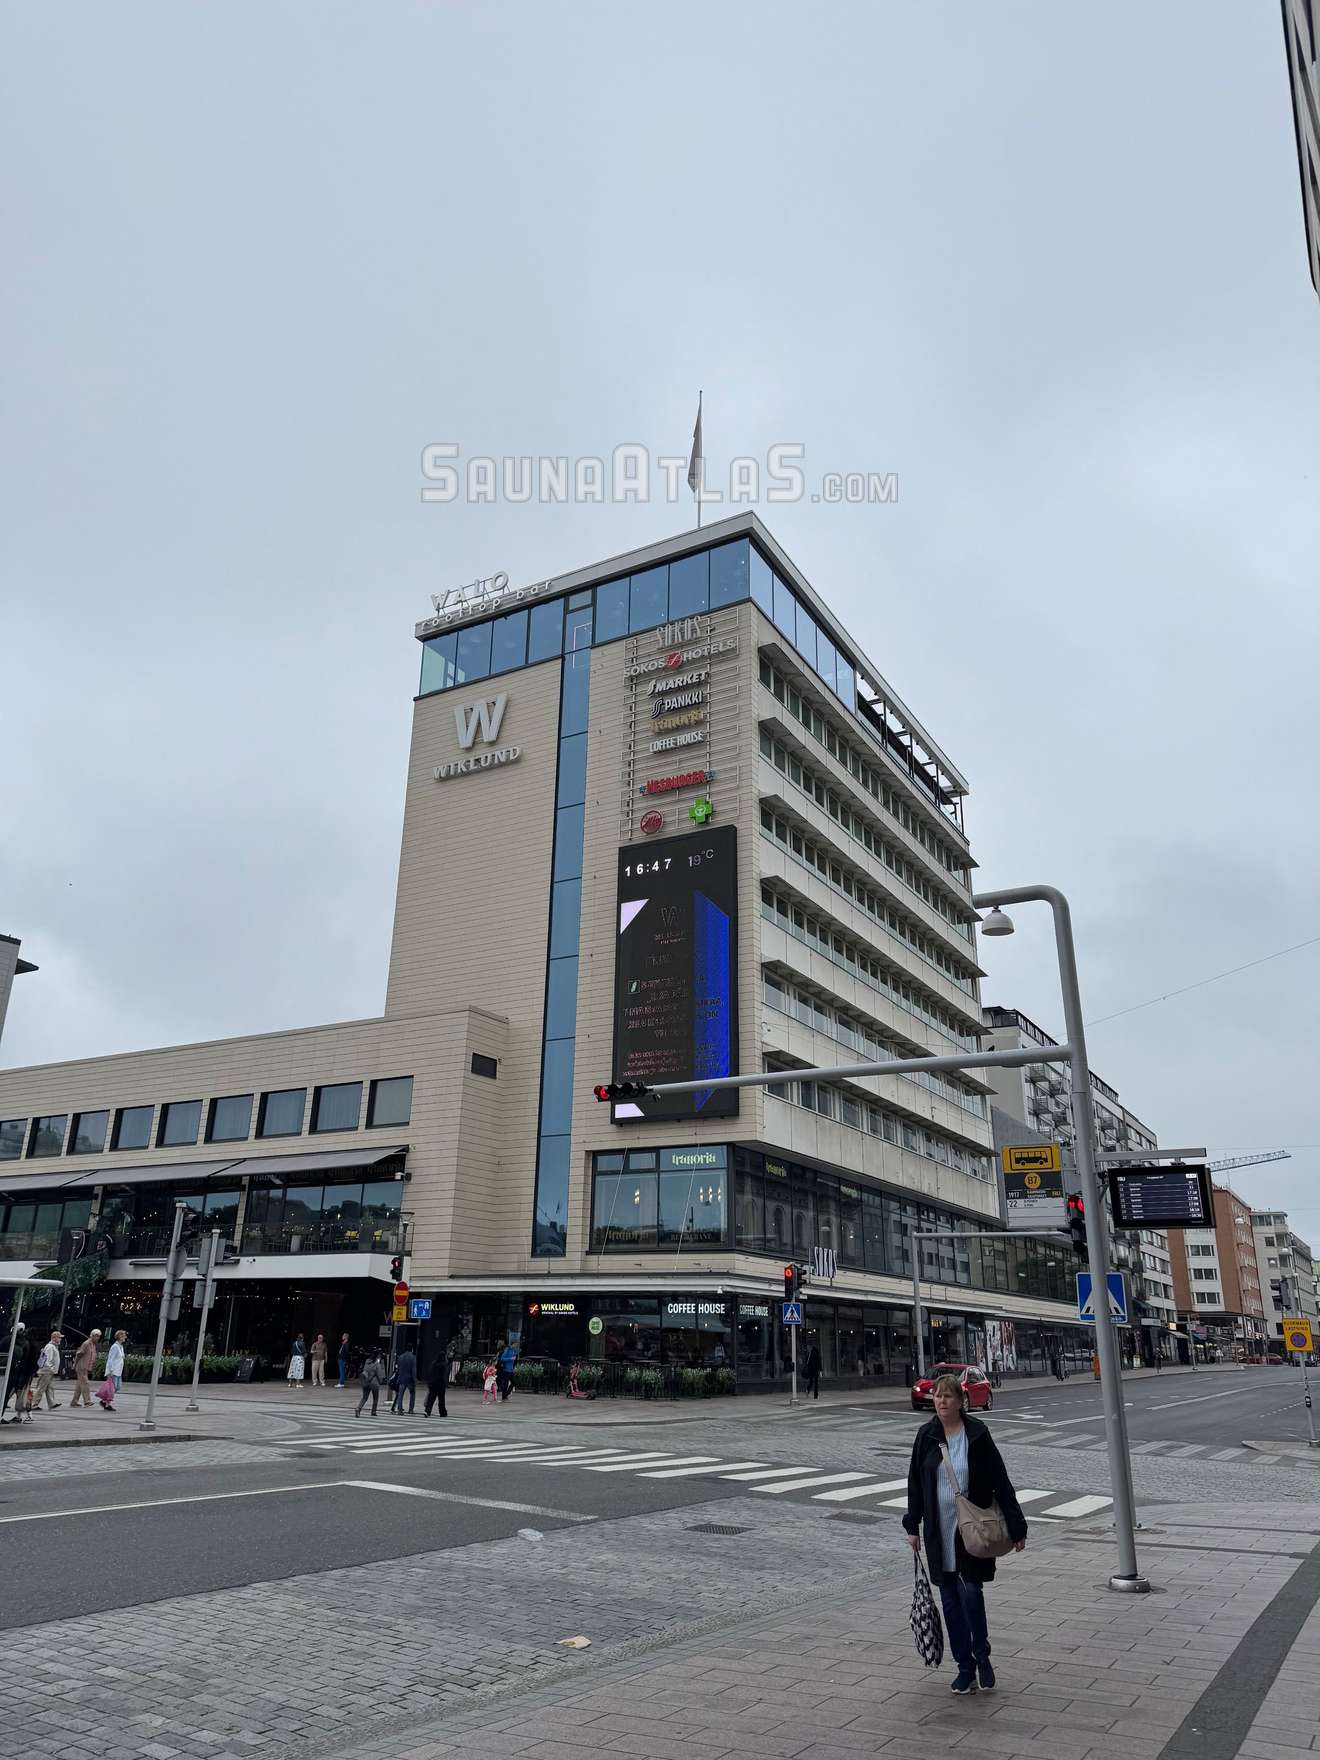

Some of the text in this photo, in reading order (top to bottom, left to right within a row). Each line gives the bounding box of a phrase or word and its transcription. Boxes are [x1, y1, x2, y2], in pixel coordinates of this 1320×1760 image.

[516, 580, 552, 600] bar
[622, 639, 737, 679] SOKOS HOTELS
[655, 671, 708, 694] MARKET
[664, 689, 704, 712] PANKKI
[453, 690, 509, 750] W
[648, 729, 706, 753] COFFEE HOUSE
[432, 745, 521, 780] WIKLUND
[624, 857, 672, 877] 16:47
[540, 1303, 575, 1312] WIKLUND
[667, 1303, 726, 1314] COFFEE HOUSE
[739, 1304, 769, 1317] COFFEE HOUSE
